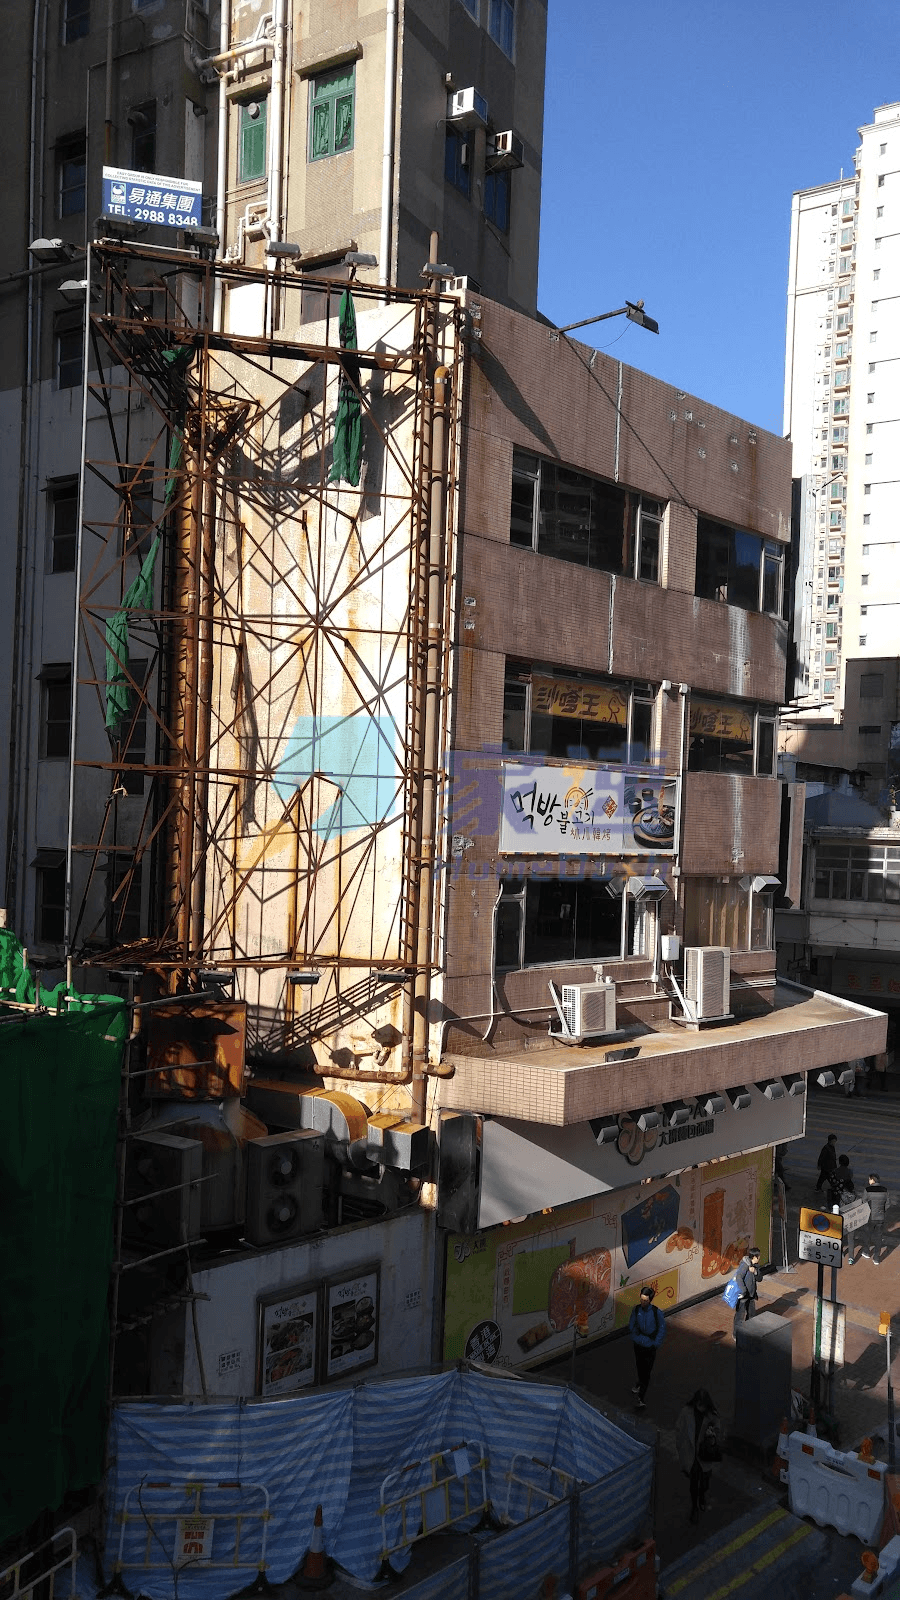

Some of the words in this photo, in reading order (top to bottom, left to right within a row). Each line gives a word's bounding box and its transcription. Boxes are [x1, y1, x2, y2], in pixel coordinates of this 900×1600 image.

[128, 187, 195, 213] 易通集團
[107, 204, 131, 217] TEL:
[134, 208, 165, 223] 2988
[168, 213, 199, 226] 8348
[536, 683, 601, 717] 沙嗲王
[510, 781, 562, 830] 먹방
[556, 810, 595, 834] 불고기
[815, 1238, 839, 1251] 8-10
[815, 1252, 835, 1262] 5-7
